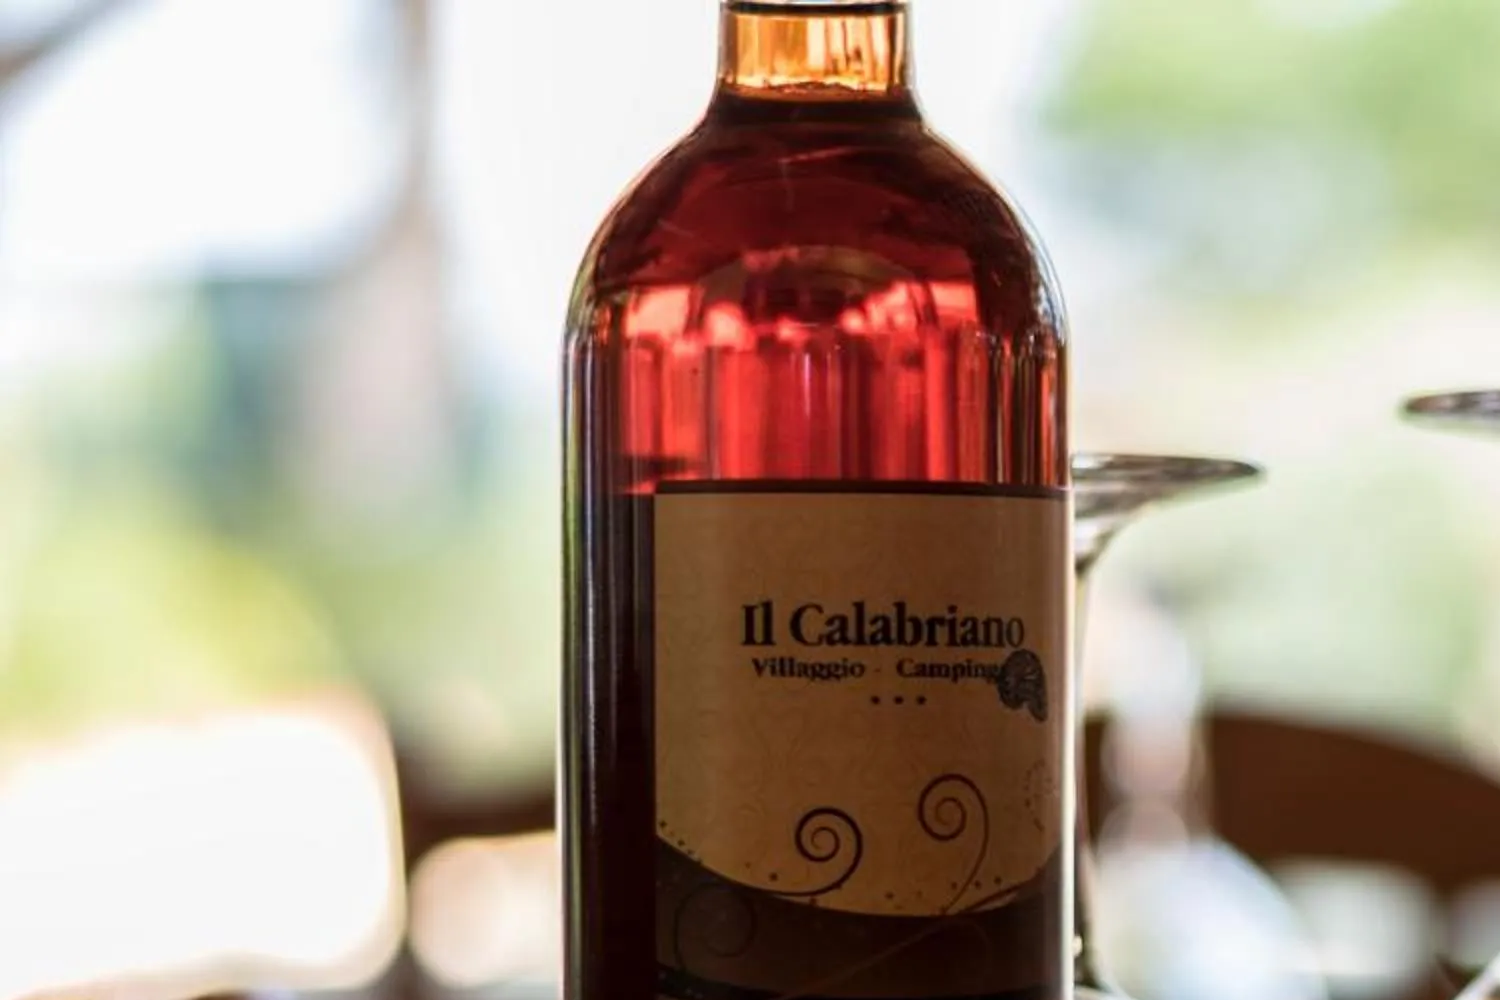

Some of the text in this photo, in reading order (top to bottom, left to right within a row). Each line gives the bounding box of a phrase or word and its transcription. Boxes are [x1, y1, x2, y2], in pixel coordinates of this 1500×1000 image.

[741, 600, 1025, 647] Il Calabriano
[751, 657, 866, 681] Villaggio
[896, 658, 1002, 684] Camping
